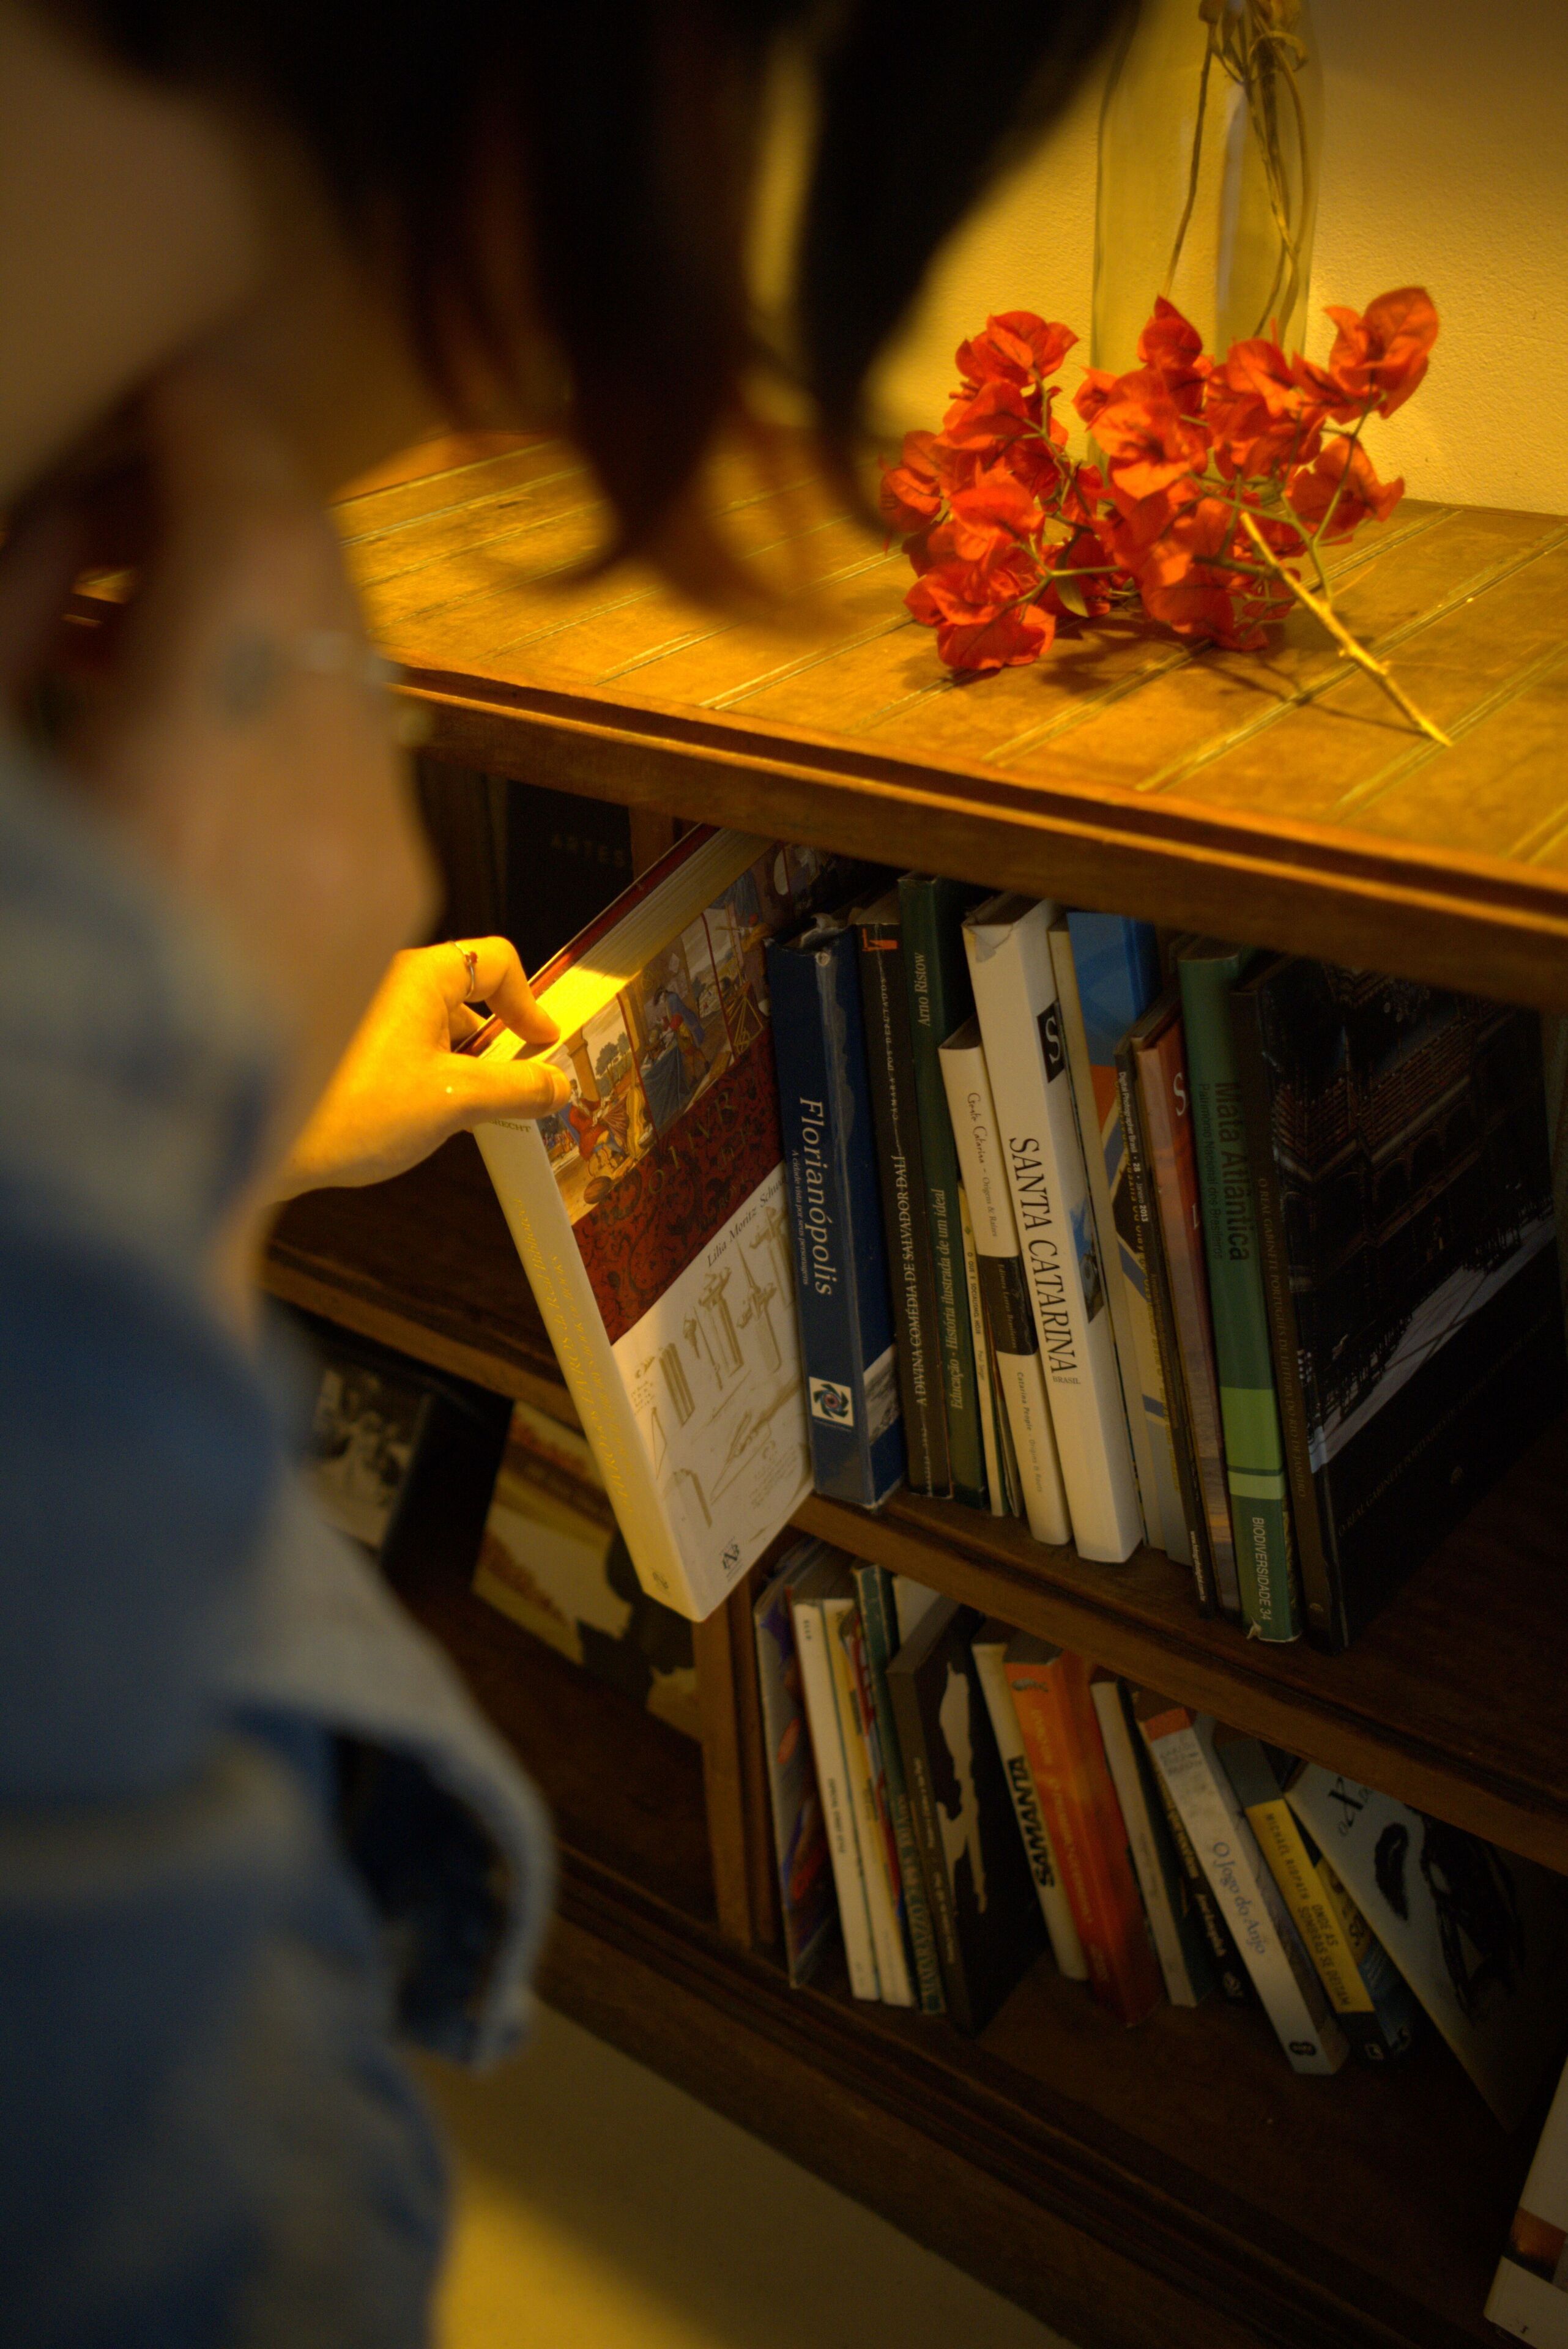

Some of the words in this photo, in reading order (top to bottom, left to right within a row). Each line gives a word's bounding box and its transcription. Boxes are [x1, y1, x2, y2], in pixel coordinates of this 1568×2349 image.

[914, 952, 928, 994] Ristow
[918, 997, 931, 1026] Arno
[1117, 1071, 1129, 1092] Digital
[1120, 1093, 1135, 1135] Photographer
[1215, 1083, 1243, 1141] Mata
[968, 1093, 980, 1121] Gente
[974, 1126, 987, 1163] Catarina
[981, 1176, 993, 1204] Origens
[1128, 1135, 1137, 1153] Brasil
[1009, 1137, 1051, 1230] SANTA
[1132, 1162, 1140, 1172] 28
[1259, 1178, 1267, 1187] O
[798, 1096, 837, 1296] Florianópolis
[933, 1188, 947, 1217] ideal
[1135, 1182, 1145, 1203] Janeiro
[1139, 1204, 1148, 1222] 2013
[1261, 1191, 1270, 1214] REAL
[707, 1242, 726, 1266] Lilia
[730, 1209, 756, 1239] Moritz
[791, 1157, 801, 1184] cidade
[798, 1237, 808, 1285] personagens
[898, 1192, 912, 1259] SALVADOR
[936, 1219, 948, 1238] um
[938, 1240, 949, 1255] de
[1265, 1219, 1277, 1269] GABINETE
[904, 1264, 915, 1281] DE
[940, 1256, 955, 1304] ilustrada
[907, 1286, 920, 1346] COMÉDIA
[1028, 1238, 1077, 1373] CATARINA
[945, 1307, 959, 1348] História
[1279, 1339, 1287, 1351] DE
[913, 1351, 925, 1394] DIVINA
[949, 1359, 965, 1408] Educação
[1018, 1372, 1027, 1403] Catarina
[1281, 1356, 1292, 1397] LEITURA
[1252, 1516, 1271, 1608] BIODIVERSIDADE
[1260, 1608, 1271, 1621] 34
[1003, 1755, 1055, 1888] SAMANTA
[1265, 1813, 1289, 1855] MICHAEL
[1211, 1840, 1231, 1858] O
[1217, 1854, 1239, 1893] Jogo
[1232, 1893, 1255, 1917] do
[1311, 1903, 1332, 1931] ONDE
[1326, 1931, 1339, 1947] AS
[1245, 1920, 1265, 1954] Anjo
